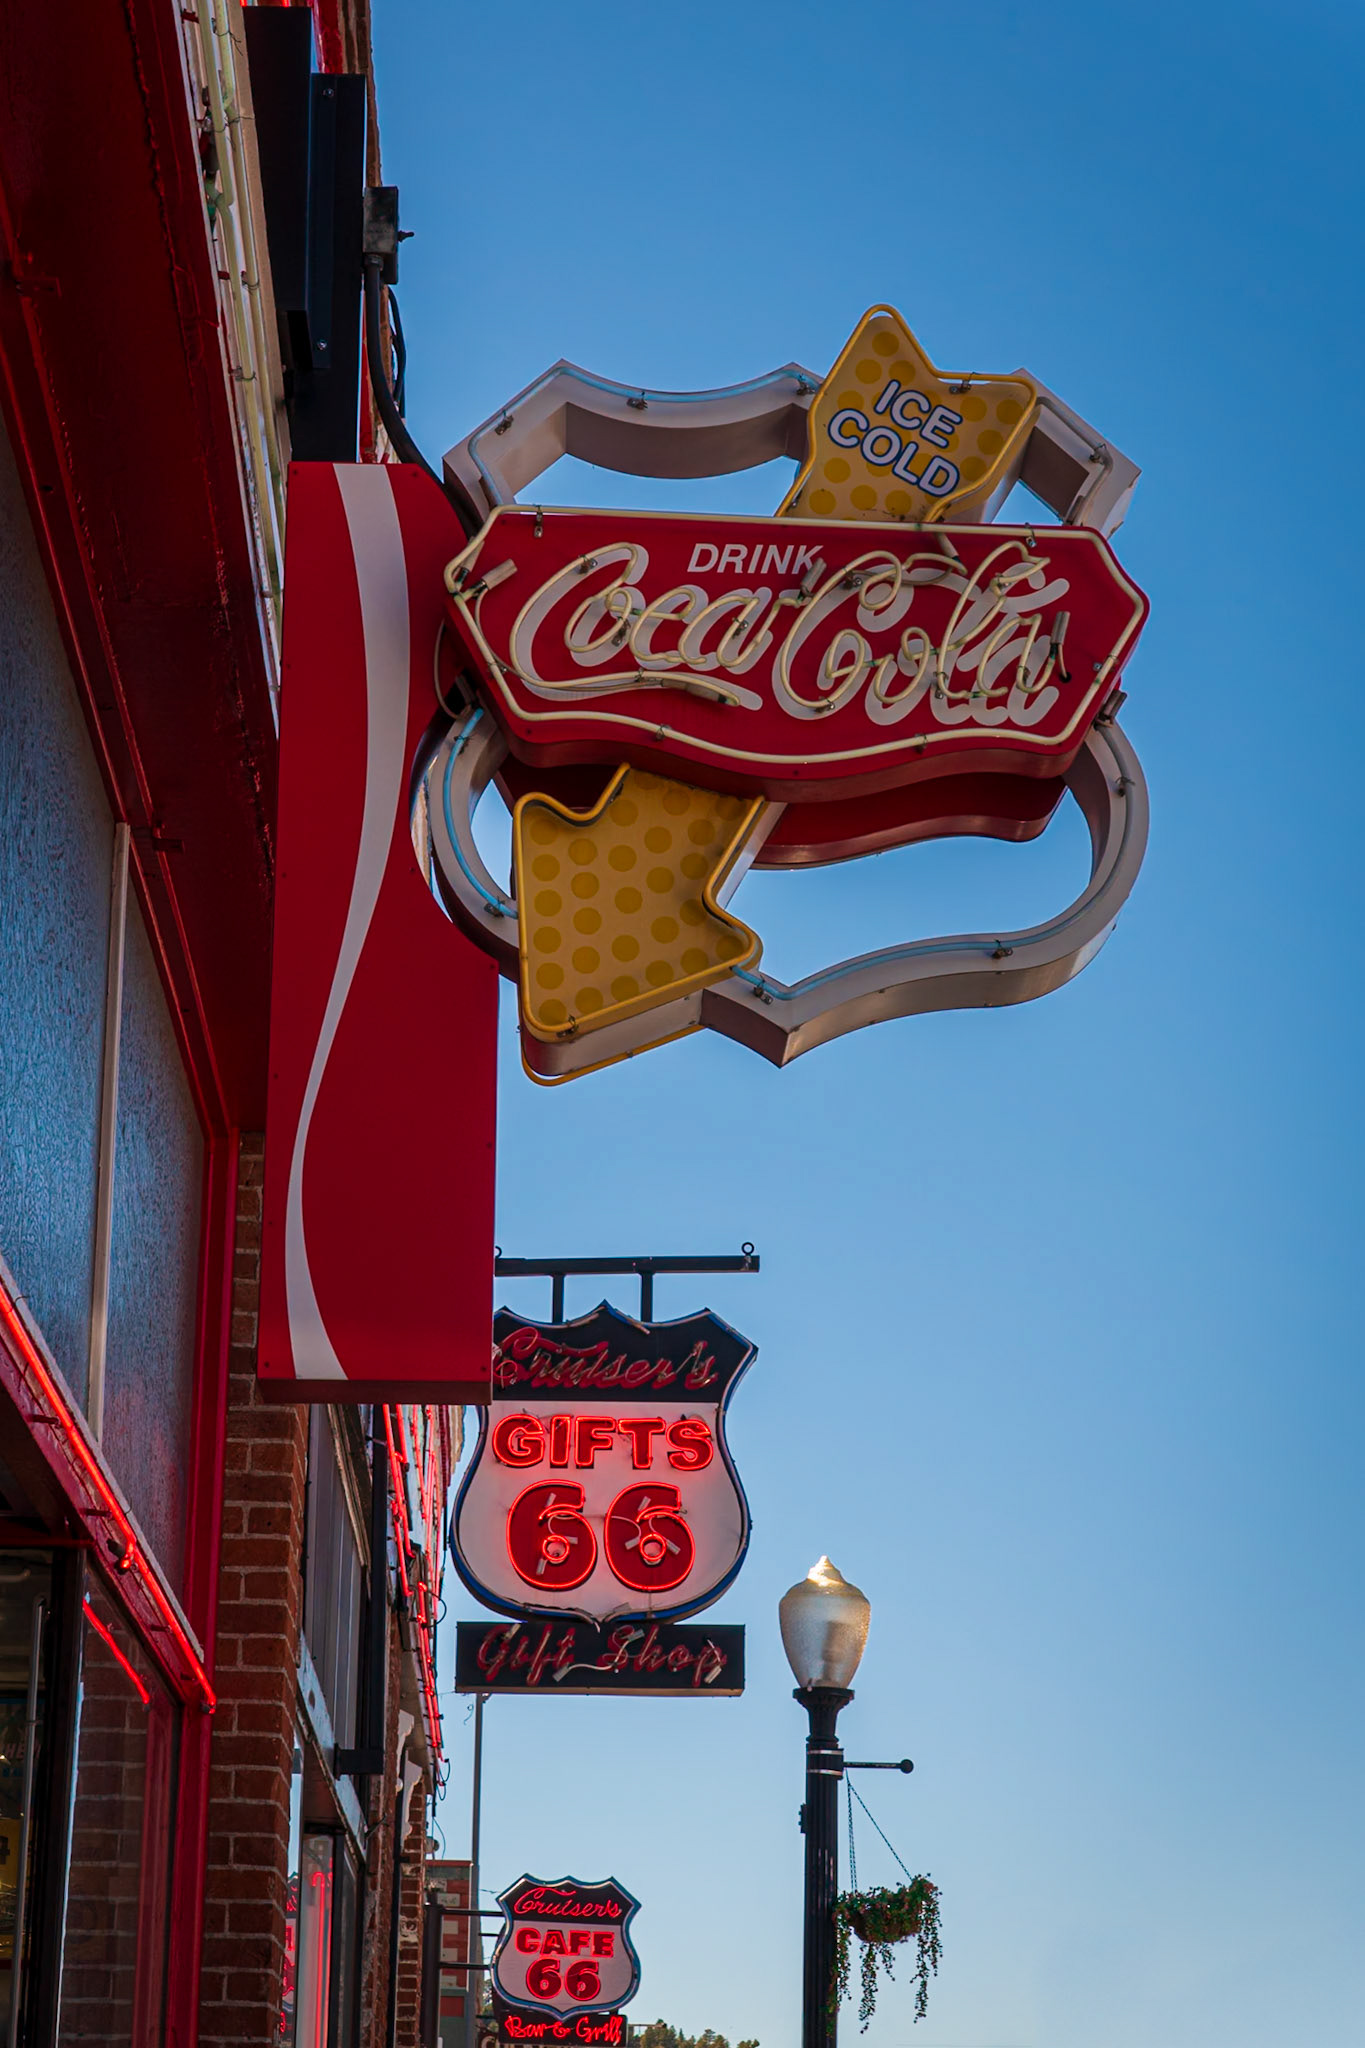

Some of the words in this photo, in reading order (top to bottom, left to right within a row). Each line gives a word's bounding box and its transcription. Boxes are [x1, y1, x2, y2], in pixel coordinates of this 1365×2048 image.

[874, 380, 963, 448] ICE
[828, 408, 960, 497] COLD
[687, 542, 824, 575] DRINK
[492, 1413, 714, 1471] GIFTS
[506, 1478, 696, 1592] 66
[477, 1623, 576, 1686] Gift
[597, 1623, 728, 1688] Shop
[515, 1927, 615, 1958] CAFE
[526, 1957, 601, 2001] 66
[504, 2015, 545, 2038] Bar
[548, 2021, 572, 2039] &
[575, 2015, 623, 2044] Grill
